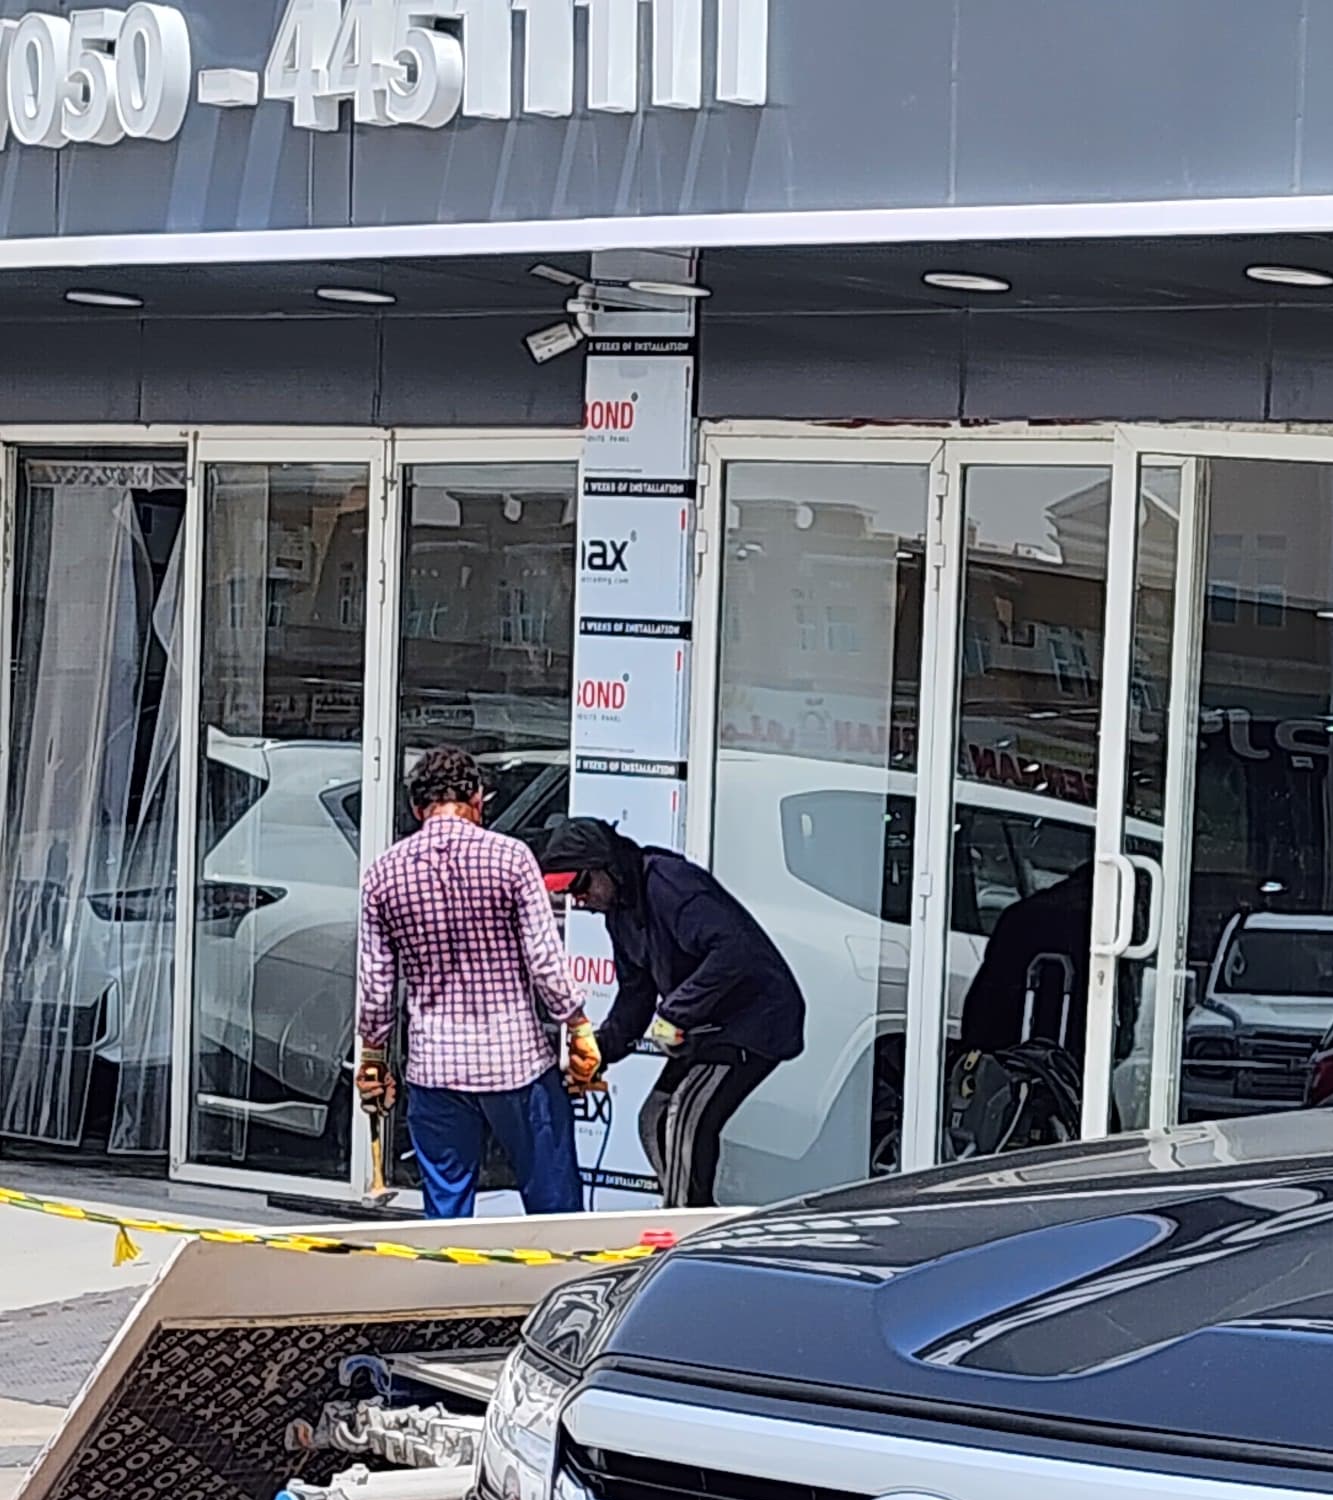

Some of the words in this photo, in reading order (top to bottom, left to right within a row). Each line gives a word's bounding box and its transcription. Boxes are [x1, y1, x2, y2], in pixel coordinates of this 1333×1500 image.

[634, 341, 689, 353] INSTALLATION
[629, 482, 684, 494] INSTALLATION
[625, 622, 681, 635] INSTALLATION
[577, 680, 625, 710] OND
[620, 761, 675, 775] INSTALLATION
[568, 955, 617, 985] OND
